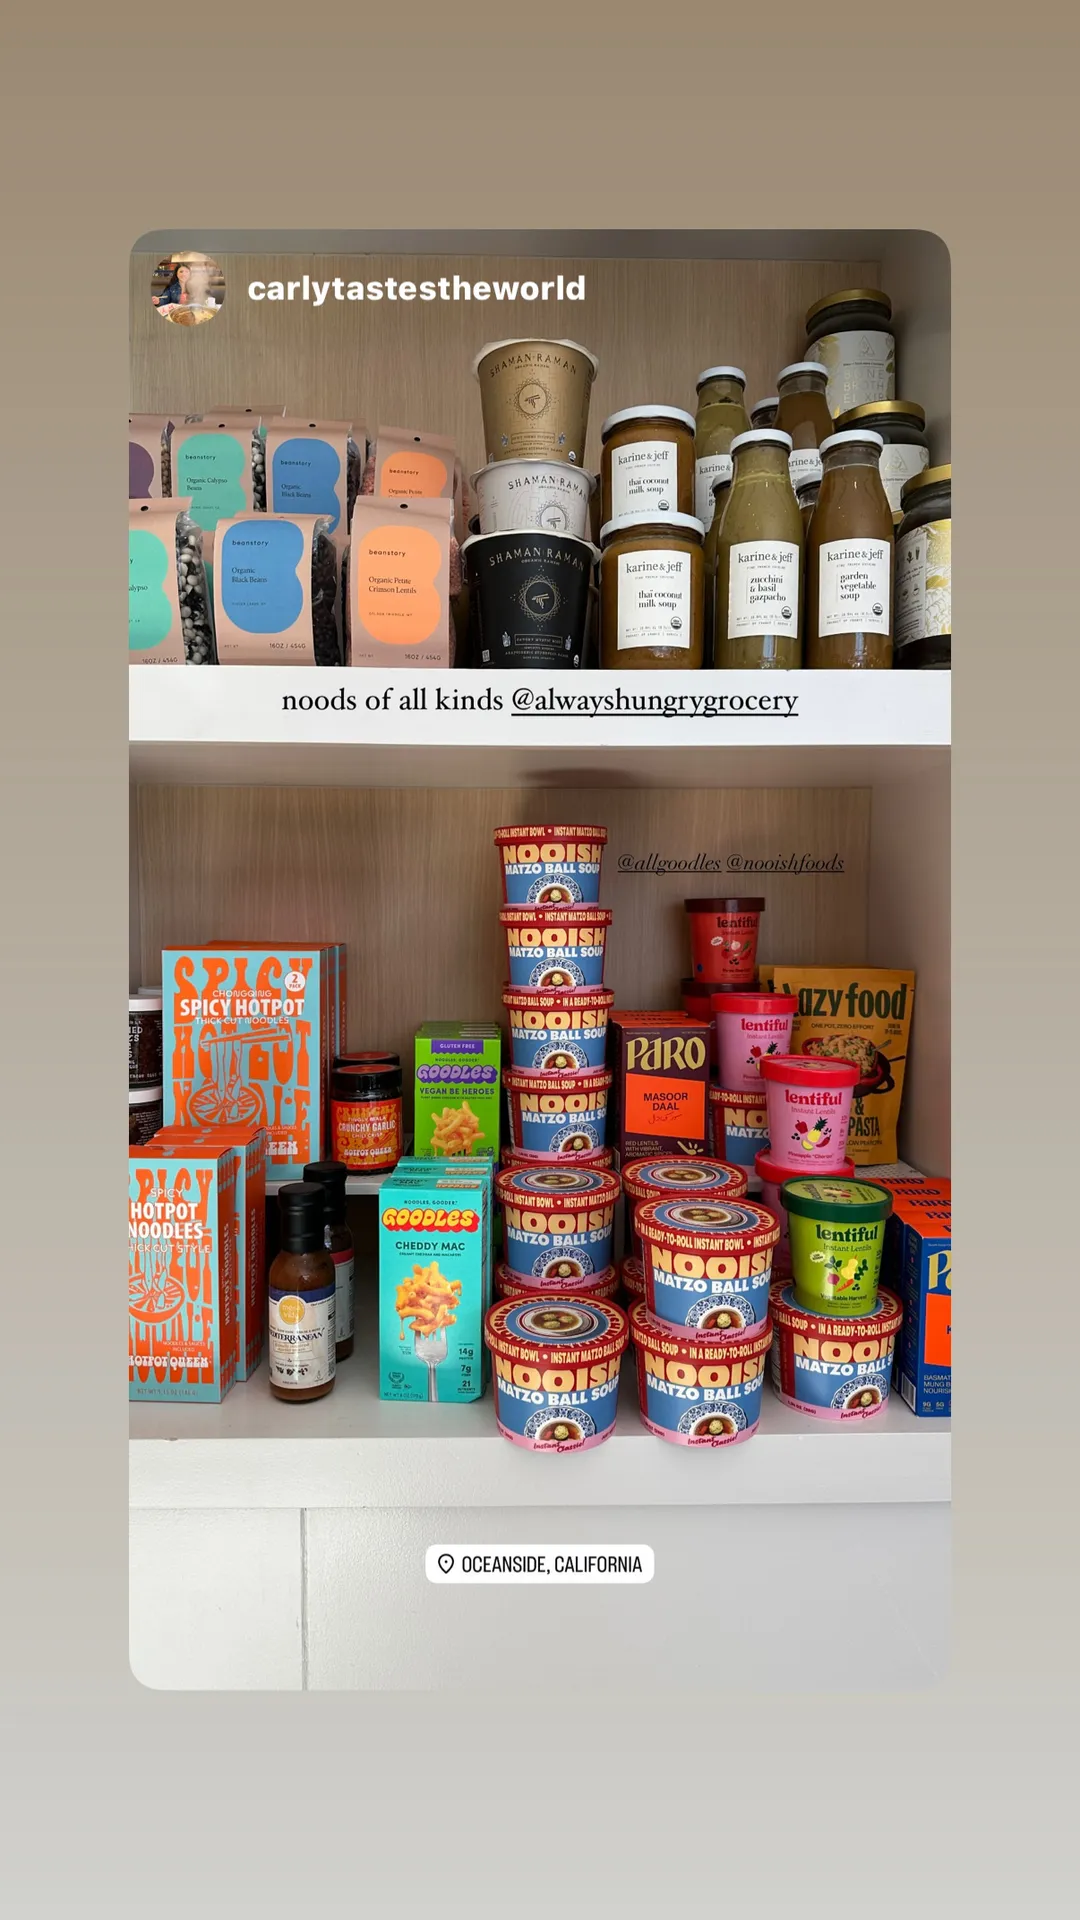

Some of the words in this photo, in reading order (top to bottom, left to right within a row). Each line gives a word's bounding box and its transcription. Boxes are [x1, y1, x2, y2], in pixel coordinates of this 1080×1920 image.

[490, 353, 532, 378] SHAMAN
[537, 353, 576, 375] RAMAN
[618, 453, 646, 466] karine
[652, 450, 670, 462] jeff
[699, 463, 726, 475] karine
[642, 478, 669, 486] coconut
[508, 476, 555, 490] SHAMAN
[560, 477, 589, 504] RAMAN
[629, 486, 645, 495] milk
[646, 487, 664, 495] soup
[369, 549, 406, 557] beanstory
[489, 547, 542, 567] SHAMAN
[547, 548, 585, 572] RAMAN
[738, 551, 770, 564] karine
[771, 553, 777, 561] &
[778, 551, 793, 564] jeff
[827, 549, 861, 562] karine
[868, 549, 884, 560] jeff
[231, 567, 256, 575] Organic
[626, 561, 659, 574] karine
[659, 563, 665, 571] &
[665, 560, 683, 574] jeff
[369, 576, 393, 585] Organic
[394, 577, 411, 585] Petite
[750, 574, 783, 584] zucchini
[840, 571, 868, 583] garden
[369, 586, 395, 594] Crimson
[758, 583, 776, 592] basil
[840, 581, 876, 592] vegetable
[654, 591, 683, 600] coconut
[749, 592, 786, 604] gazpacho
[840, 592, 860, 601] soup
[638, 599, 656, 608] milk
[658, 601, 677, 611] soup
[503, 843, 602, 865] NOOISH
[505, 864, 542, 875] MATZO
[545, 864, 576, 874] BALL
[578, 863, 600, 874] SOUP
[716, 915, 759, 928] lentiful
[507, 928, 606, 947] NOOISH
[509, 947, 544, 958] MATZO
[546, 947, 578, 957] BALL
[580, 946, 604, 957] SOUP
[292, 974, 298, 983] 2
[212, 990, 272, 998] CHONGQING
[180, 998, 231, 1017] SPICY
[235, 998, 305, 1017] HOTPOT
[540, 997, 554, 1006] SOUP
[845, 982, 908, 1020] food
[195, 1016, 223, 1025] THICK
[223, 1017, 245, 1025] CUT
[245, 1016, 290, 1025] NOODLES
[509, 1009, 608, 1030] NOOISH
[741, 1017, 788, 1032] lentiful
[511, 1028, 547, 1041] MATZO
[550, 1029, 581, 1041] BALL
[584, 1027, 606, 1039] SOUP
[562, 1080, 576, 1089] SOUP
[520, 1089, 608, 1114] NOOIS
[643, 1092, 688, 1102] MASOOR
[785, 1089, 842, 1106] lentiful
[652, 1102, 679, 1111] DAAL
[522, 1111, 567, 1125] MATZO
[569, 1111, 596, 1124] BALL
[338, 1122, 370, 1133] CRUNCHY
[372, 1120, 396, 1132] GARLIC
[848, 1116, 880, 1136] PASTA
[150, 1188, 184, 1198] SPICY
[536, 1196, 555, 1208] BOWL
[564, 1196, 588, 1208] INSTANT
[130, 1202, 199, 1220] HOTPOT
[505, 1203, 614, 1235] NOOISH
[128, 1222, 204, 1239] NOODLES
[507, 1226, 549, 1246] MATZO
[553, 1234, 587, 1246] BALL
[590, 1223, 613, 1243] SOUP
[815, 1224, 879, 1243] lentiful
[395, 1241, 438, 1251] CHEDDY
[441, 1242, 465, 1251] MAC
[648, 1228, 693, 1249] READY-TO-ROLL
[693, 1238, 724, 1250] INSTANT
[724, 1239, 745, 1251] BOWL
[128, 1244, 151, 1253] HICK
[153, 1244, 175, 1253] CUT
[177, 1244, 210, 1253] STYLE
[823, 1243, 849, 1252] Instant
[850, 1244, 872, 1252] Lentils
[651, 1244, 772, 1280] NOOIS
[540, 1278, 565, 1287] Instant
[653, 1268, 707, 1293] MATZO
[711, 1279, 748, 1294] BALL
[820, 1292, 847, 1301] Vegetable
[792, 1316, 808, 1331] SOUP
[818, 1323, 826, 1334] IN
[833, 1322, 881, 1337] READY-TO-ROLL
[270, 1328, 325, 1344] DITERRANEAN
[695, 1331, 722, 1341] Instant
[459, 1348, 474, 1357] 14g
[648, 1337, 661, 1350] BALL
[661, 1343, 679, 1354] SOUP
[689, 1345, 697, 1358] IN
[704, 1342, 753, 1360] READY-TO-ROLL
[520, 1350, 540, 1363] BOWL
[551, 1352, 580, 1364] INSTANT
[580, 1349, 603, 1362] MATZO
[170, 1356, 209, 1371] QUEEN
[460, 1365, 472, 1373] 7g
[645, 1350, 766, 1388] NOOIS
[796, 1356, 854, 1376] MATZO
[857, 1361, 887, 1376] BALL
[495, 1353, 621, 1393] NOOISH
[497, 1375, 544, 1405] MATZO
[547, 1392, 588, 1406] BALL
[591, 1375, 620, 1401] SOUP
[646, 1374, 700, 1400] MATZO
[704, 1387, 742, 1401] BALL
[840, 1408, 866, 1419] Instant
[533, 1441, 560, 1450] Instant
[687, 1437, 715, 1445] Instant
